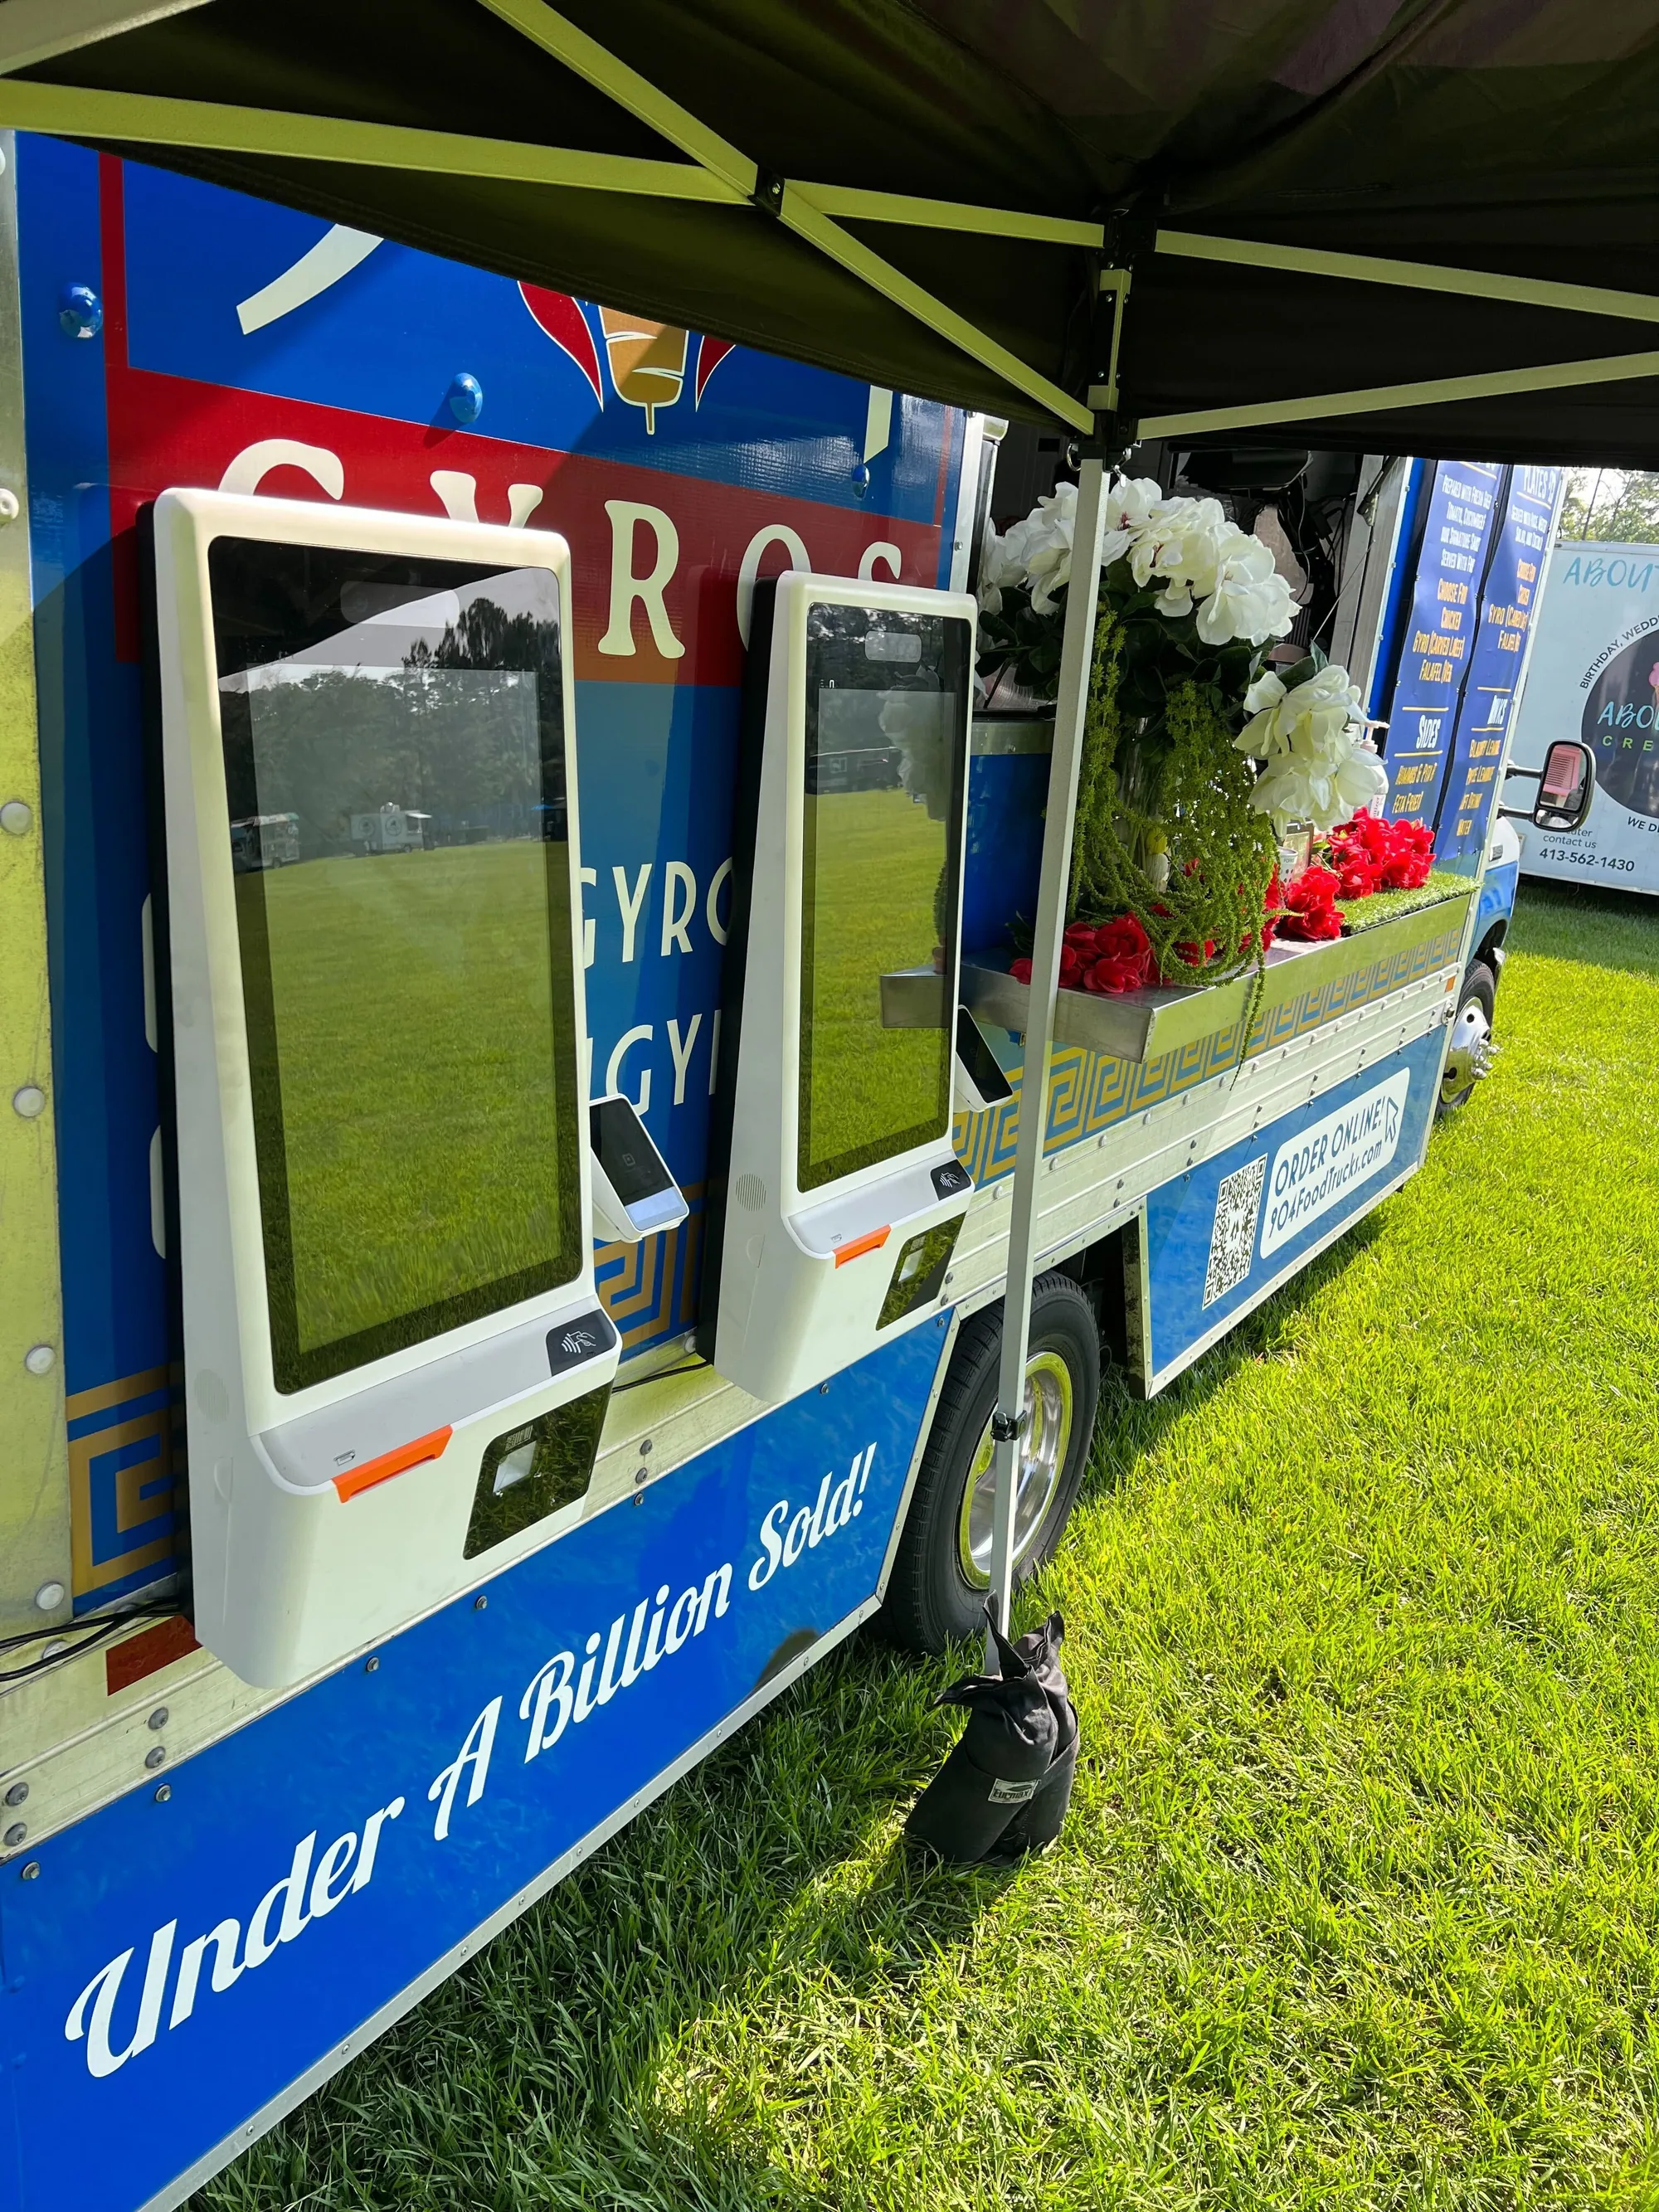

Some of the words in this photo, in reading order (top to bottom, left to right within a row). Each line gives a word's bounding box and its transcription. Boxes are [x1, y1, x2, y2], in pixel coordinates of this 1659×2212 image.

[1563, 557, 1659, 592] ABOU
[1579, 639, 1623, 689] BIRTHDAY,
[1622, 615, 1659, 640] WEDD
[1416, 715, 1441, 750] SIDES
[1627, 816, 1646, 829] WE
[1543, 834, 1582, 847] contact
[1584, 840, 1597, 848] us
[1539, 848, 1635, 872] 413-562-1430
[1275, 1137, 1328, 1197] ORDER
[1331, 1096, 1386, 1158] ONLINE!
[1269, 1141, 1383, 1238] 904FoodTrucks.com
[65, 1796, 405, 2078] Under
[427, 1695, 503, 1841] A
[519, 1562, 733, 1765] Billion
[748, 1441, 877, 1592] Sold!
